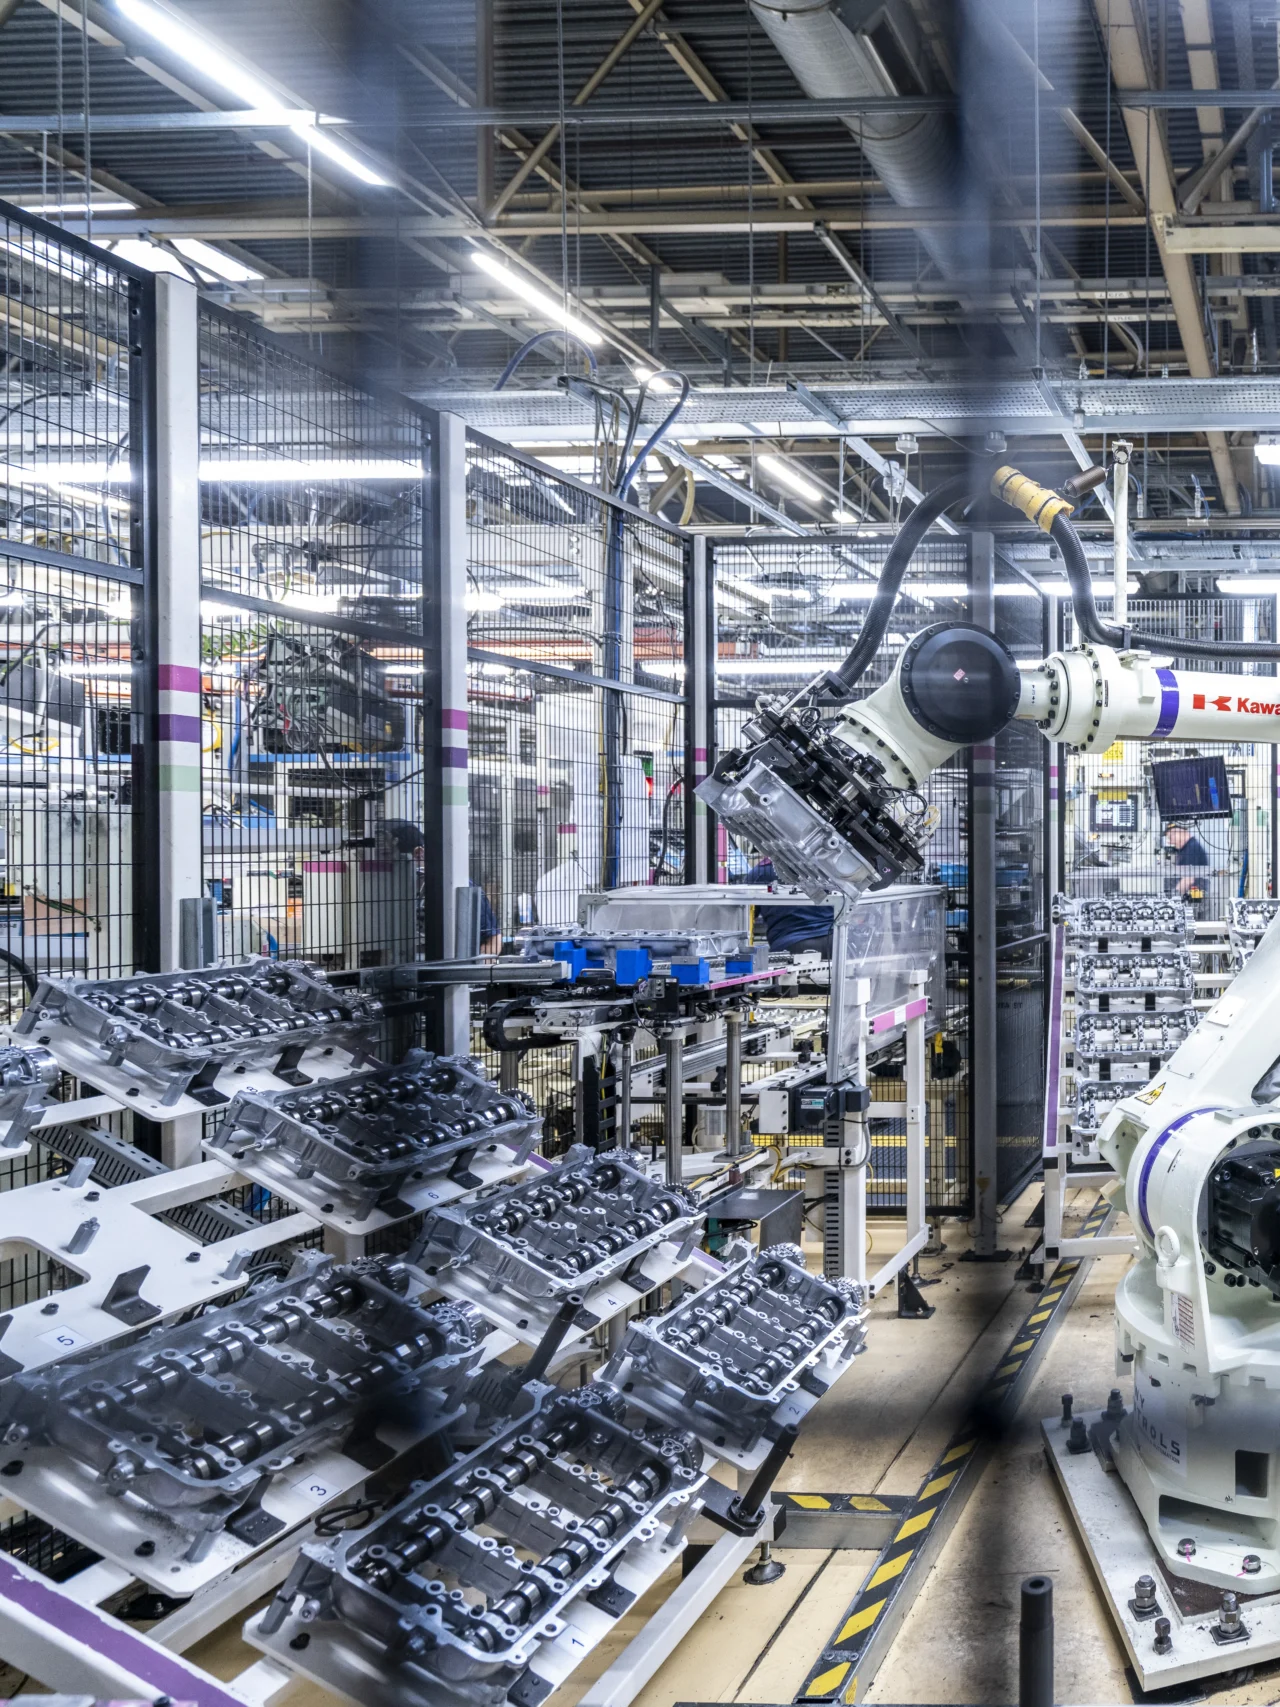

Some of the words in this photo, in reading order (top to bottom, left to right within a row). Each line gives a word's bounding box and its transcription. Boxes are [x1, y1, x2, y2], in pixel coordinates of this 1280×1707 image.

[427, 1191, 440, 1200] 6
[607, 1298, 617, 1306] 4
[56, 1335, 75, 1346] 5
[310, 1485, 327, 1496] 3
[571, 1637, 585, 1648] 1
